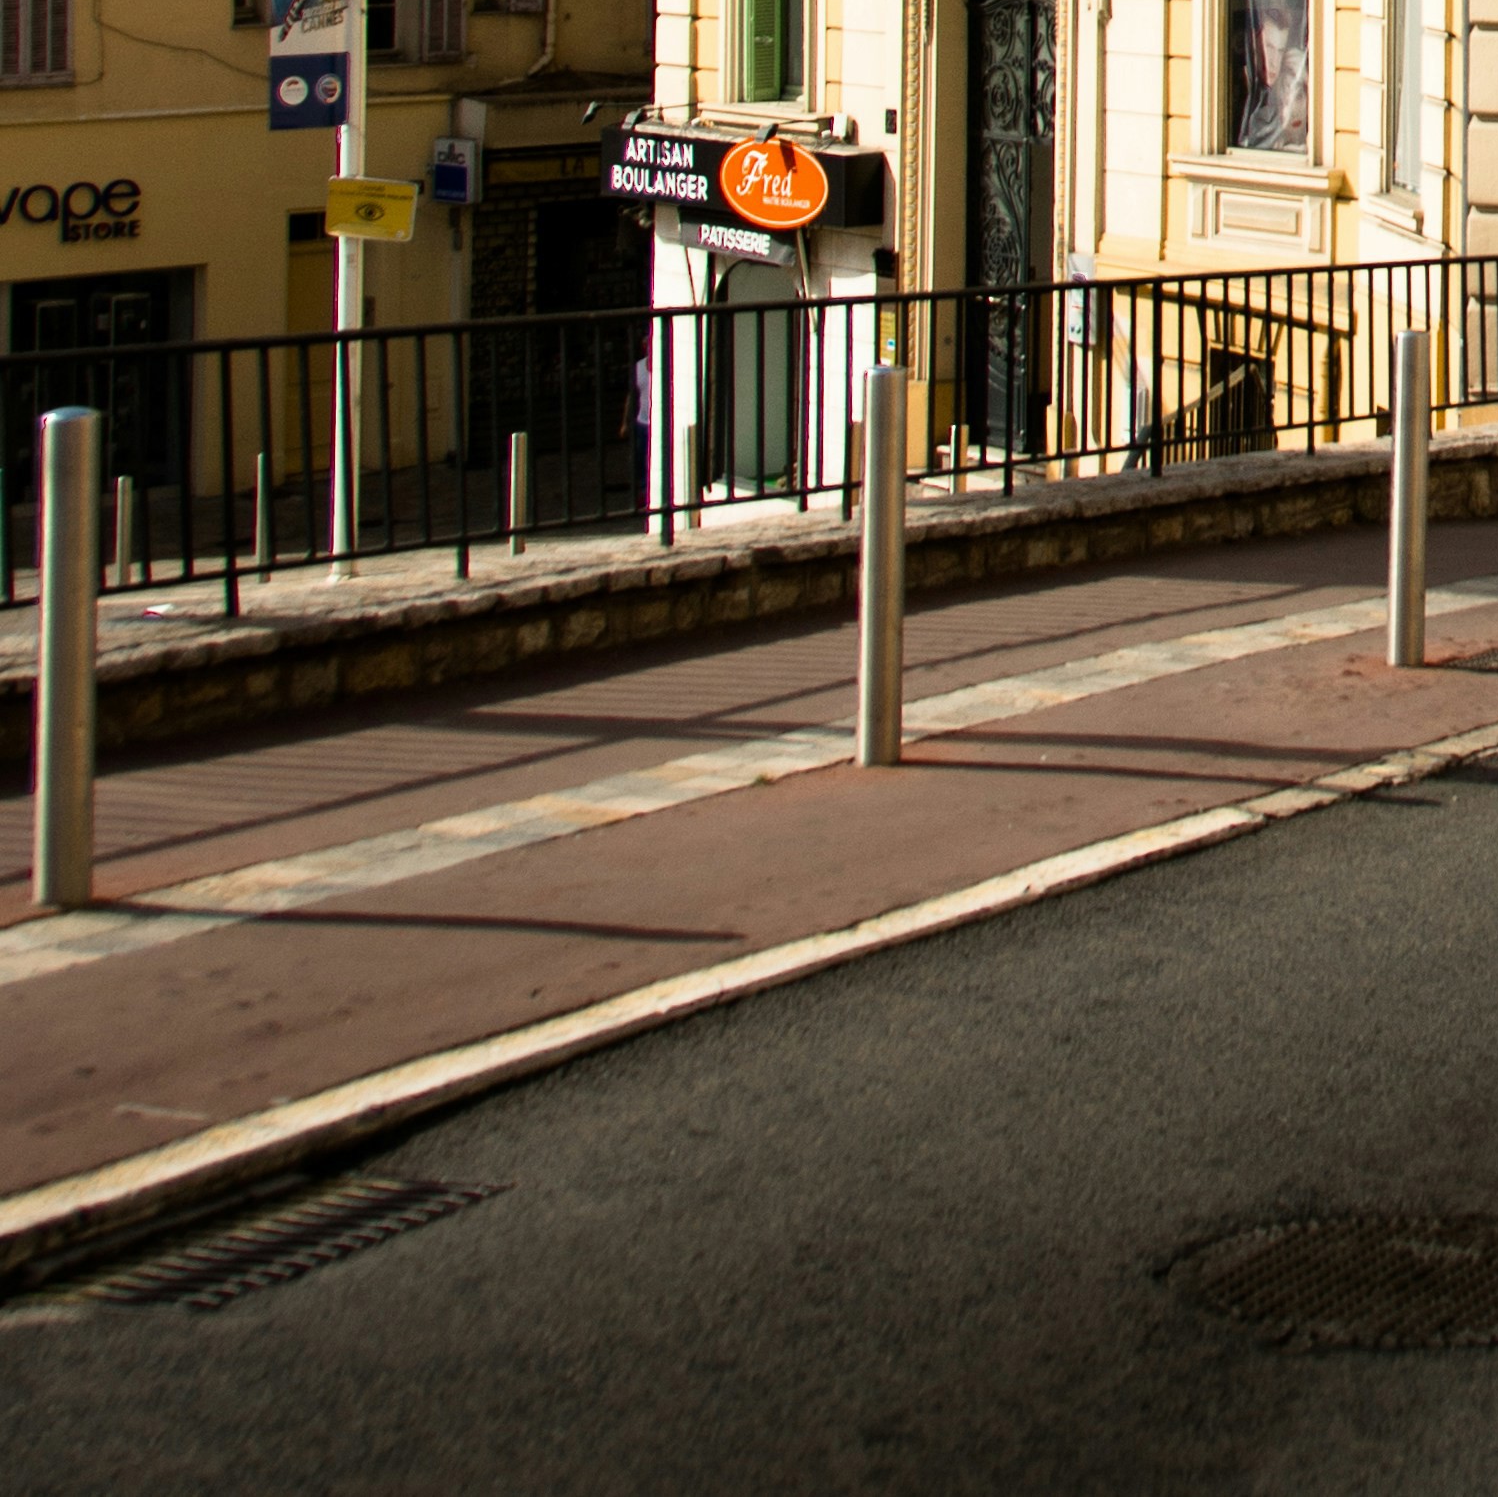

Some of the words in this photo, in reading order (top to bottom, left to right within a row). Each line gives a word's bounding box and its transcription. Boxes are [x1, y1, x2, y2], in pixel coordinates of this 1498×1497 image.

[625, 136, 695, 168] ARTISAN
[611, 164, 708, 201] BOULANGER
[736, 150, 792, 197] Fred
[68, 219, 141, 242] STORE
[700, 224, 771, 255] PATISSERIE
